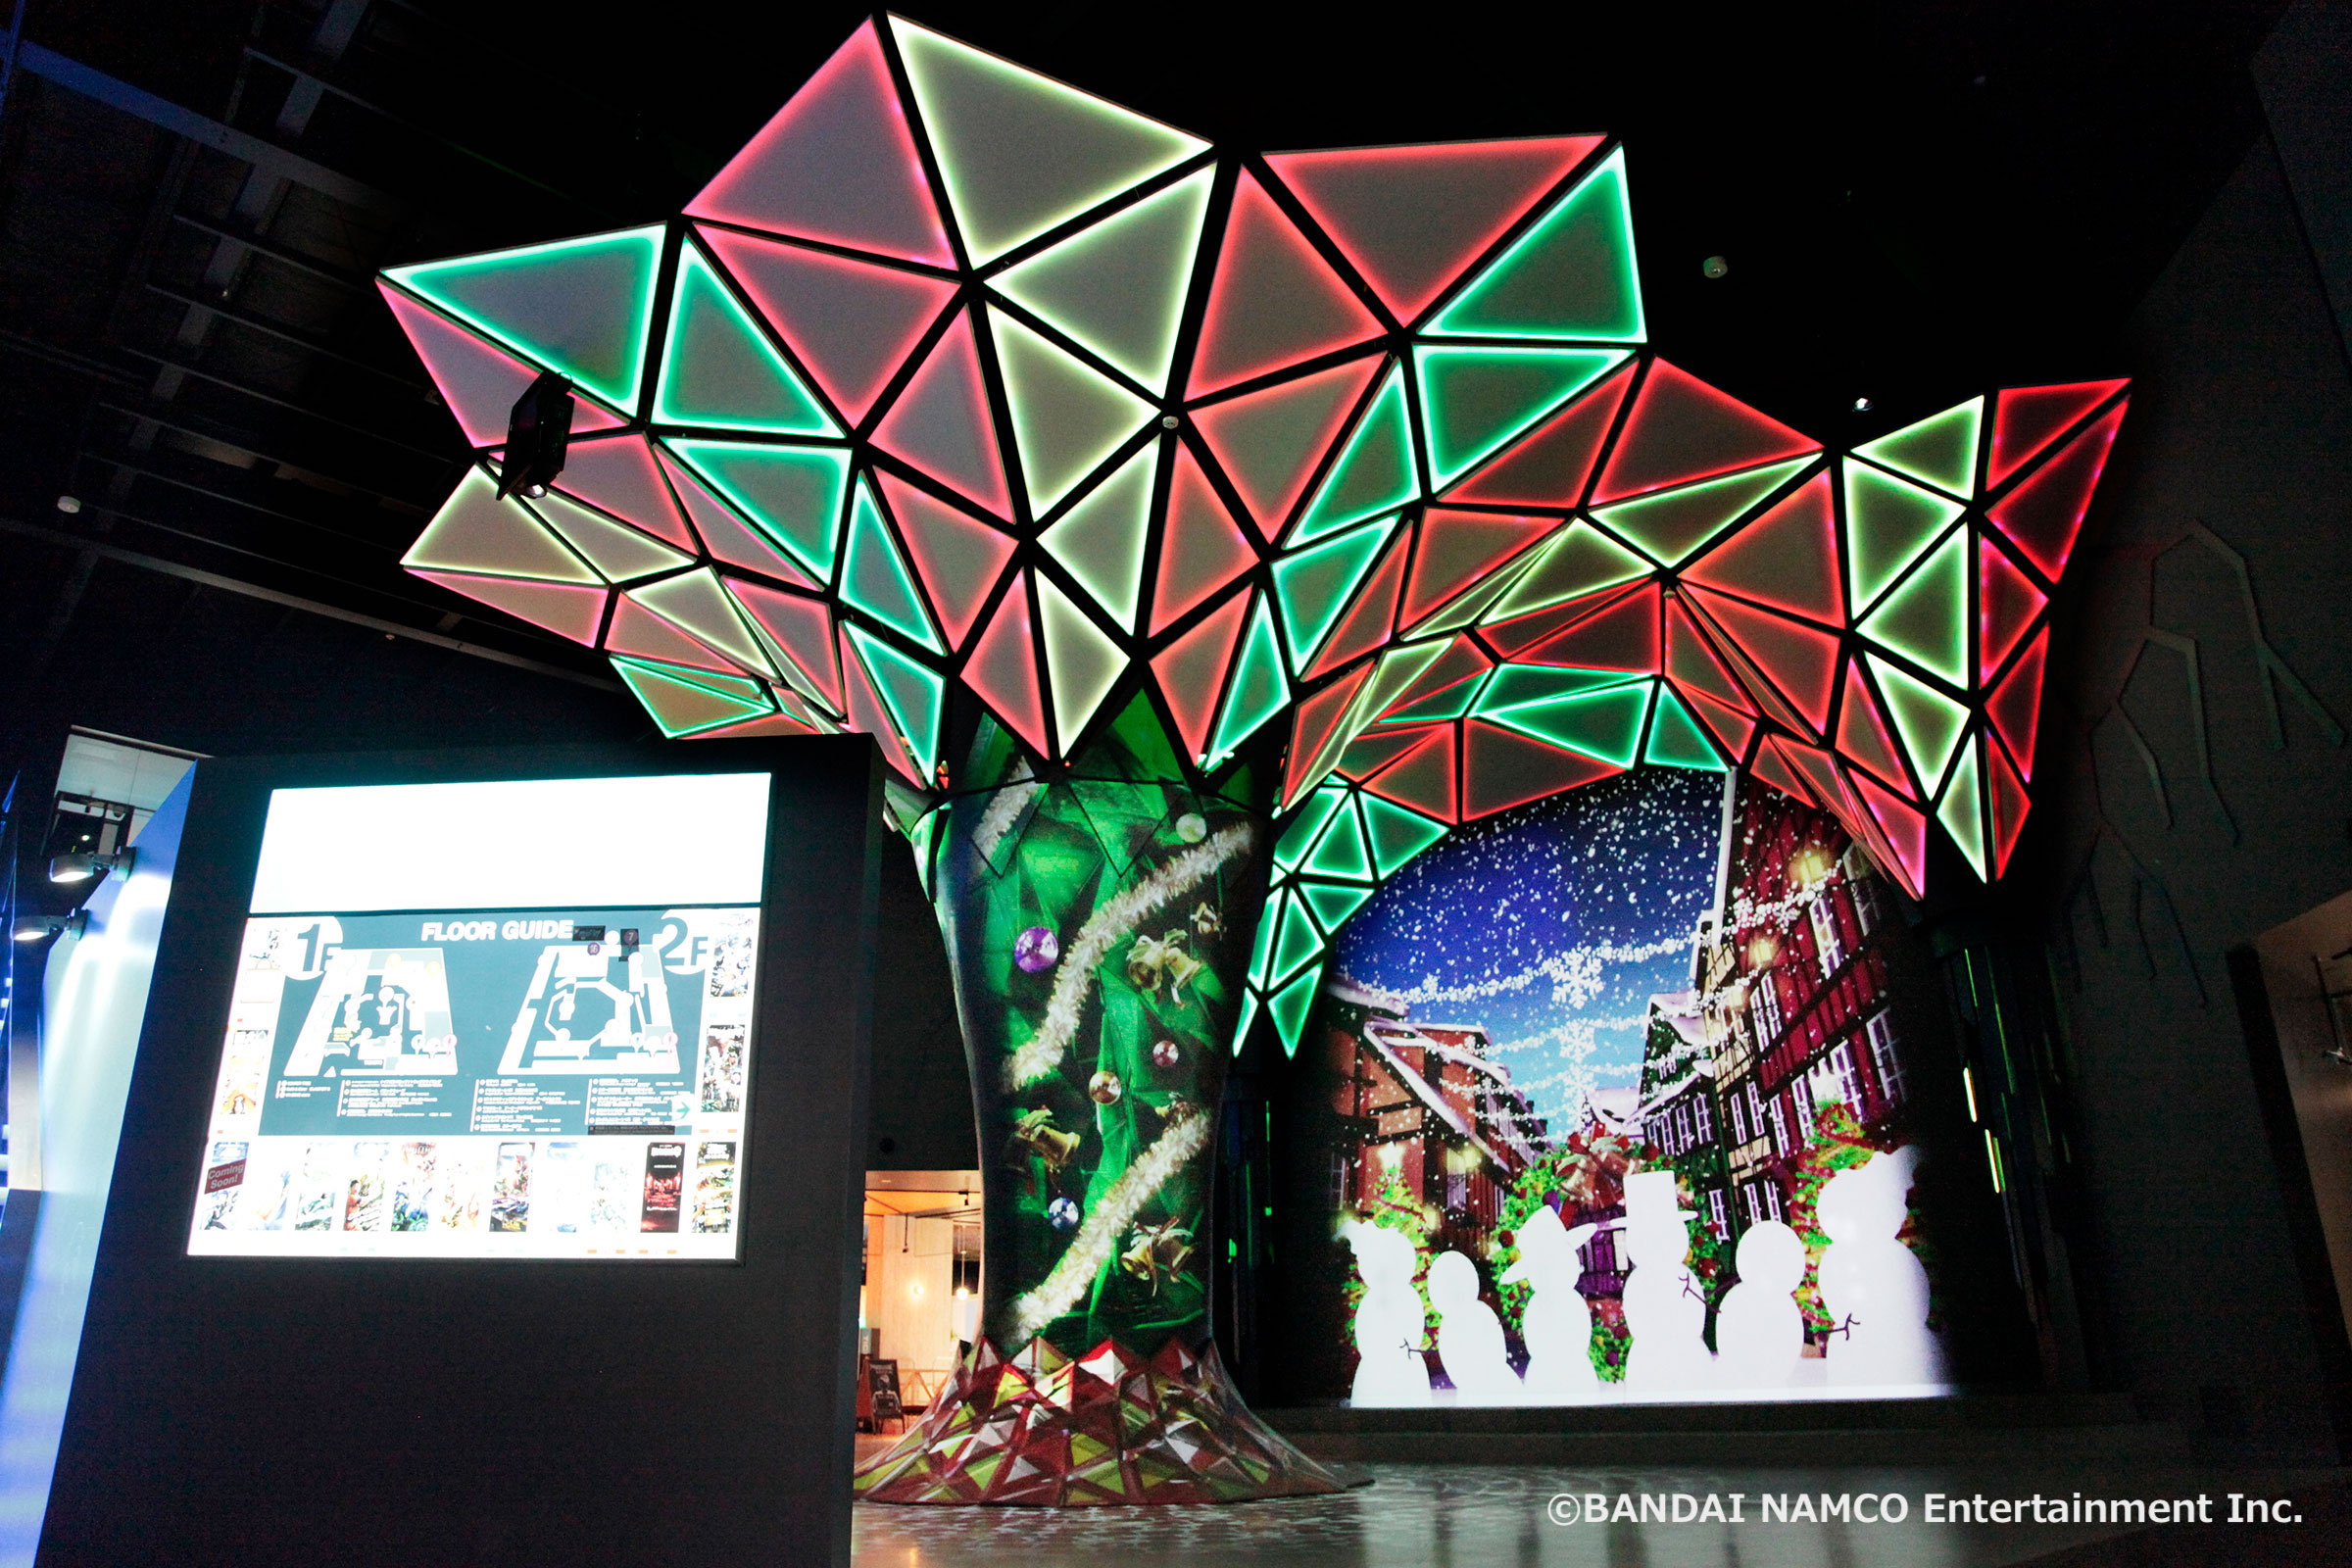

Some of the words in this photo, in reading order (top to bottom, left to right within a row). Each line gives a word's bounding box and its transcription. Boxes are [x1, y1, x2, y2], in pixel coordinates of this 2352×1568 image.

[420, 921, 497, 941] FLOOR
[502, 920, 574, 940] GUIDE
[660, 916, 709, 966] 2F
[209, 1163, 244, 1179] Coming
[211, 1175, 238, 1189] Soon!
